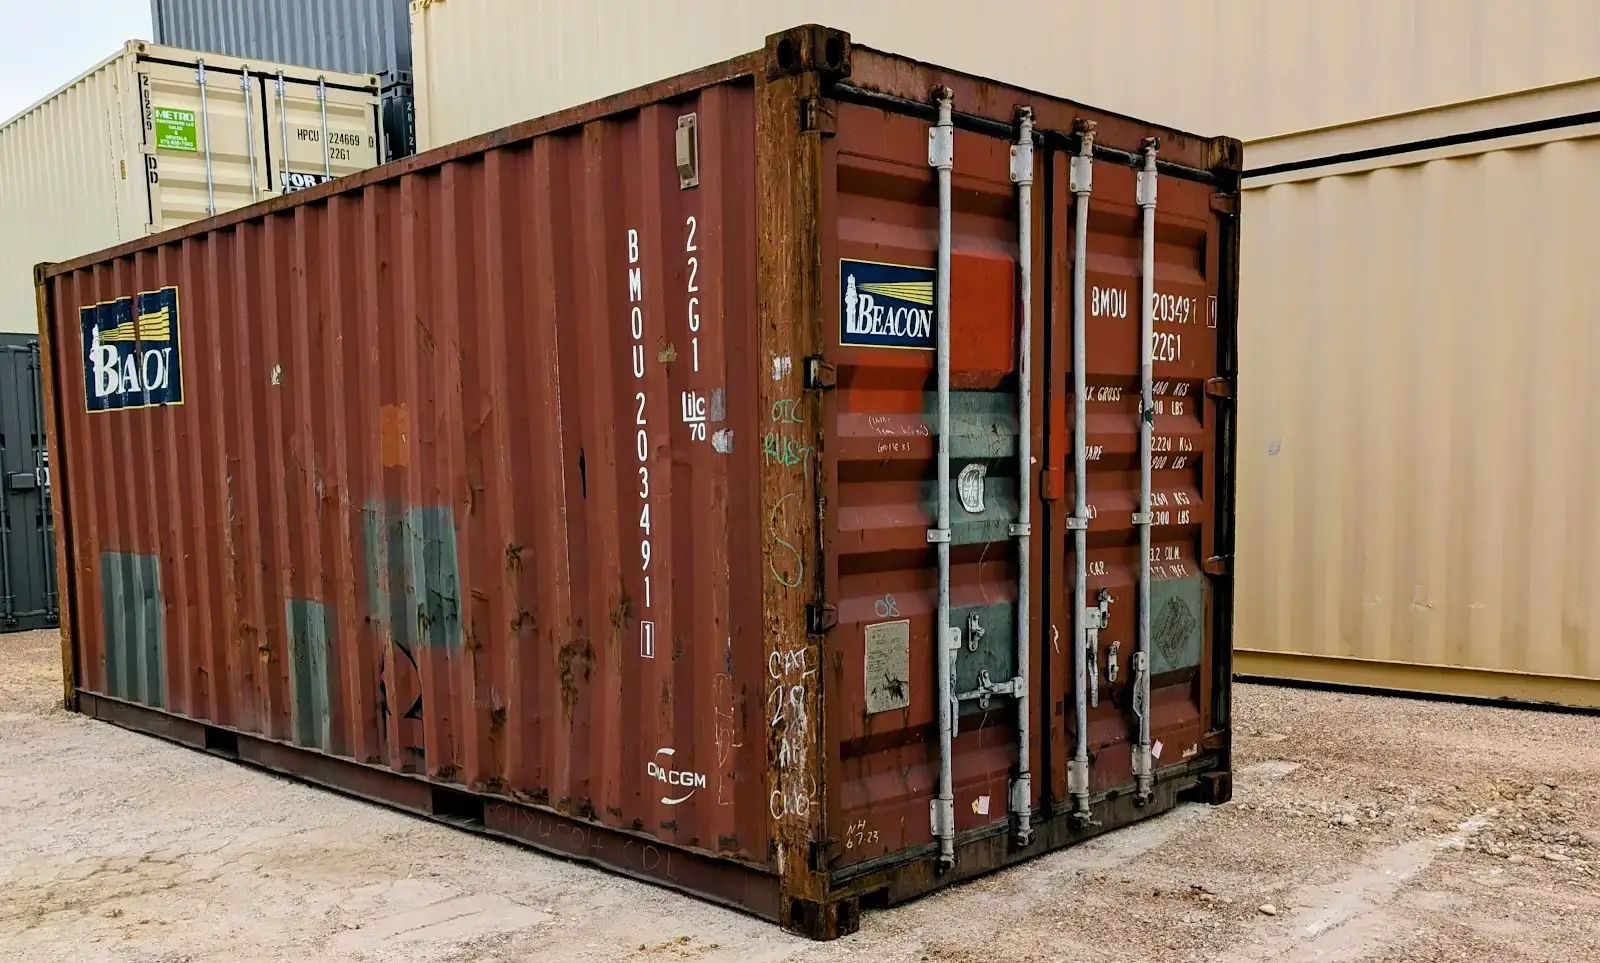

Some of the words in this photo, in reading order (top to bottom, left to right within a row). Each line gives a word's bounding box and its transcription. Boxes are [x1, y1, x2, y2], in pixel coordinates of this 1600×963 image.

[155, 109, 194, 122] METRO
[297, 128, 320, 142] HPCU
[328, 132, 360, 147] 224669
[330, 147, 350, 161] 22G1
[686, 216, 699, 372] 22G1
[628, 229, 644, 378] BMOU
[1091, 286, 1127, 318] BMOU
[1152, 292, 1197, 324] 203491
[854, 293, 934, 338] BEACON
[1152, 332, 1181, 361] 22G1
[1097, 387, 1122, 401] GROSS
[1173, 383, 1190, 397] KGS
[1172, 401, 1184, 416] LBS
[689, 423, 706, 441] 70
[1085, 446, 1103, 460] TARE
[1150, 456, 1168, 469] 900
[1172, 457, 1188, 469] LBS
[635, 392, 651, 608] 203491
[1150, 511, 1170, 525] 2.300
[1178, 510, 1190, 525] LBS
[1150, 547, 1160, 561] 3.2
[669, 771, 706, 789] CGM
